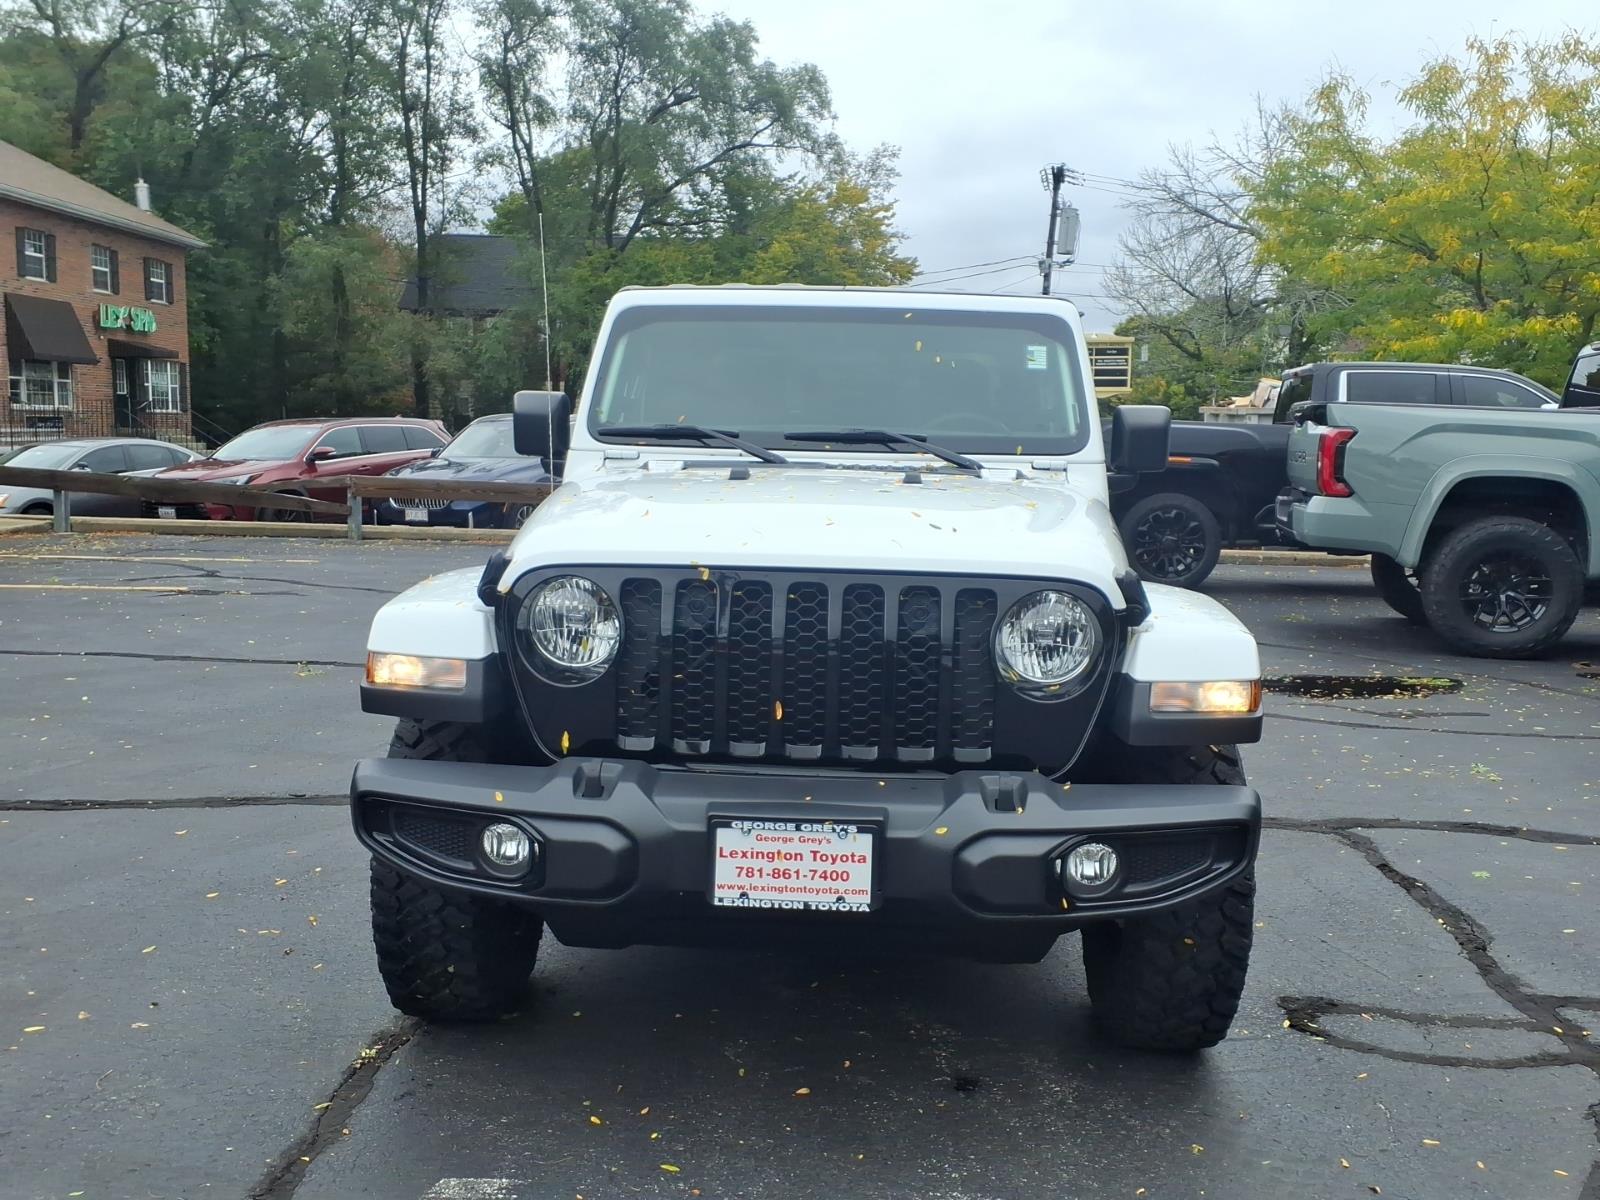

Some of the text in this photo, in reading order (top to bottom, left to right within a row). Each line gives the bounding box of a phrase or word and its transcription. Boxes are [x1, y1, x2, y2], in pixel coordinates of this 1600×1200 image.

[100, 303, 129, 329] LEX
[731, 820, 857, 833] GEORGE GREY'S
[755, 833, 832, 845] George Grey's
[719, 846, 867, 865] Lexington Toyota
[735, 866, 850, 882] 781-861-7400
[716, 882, 869, 896] www.lexingtontoyota.com
[714, 897, 871, 912] LEXINGTON TOYOTA
